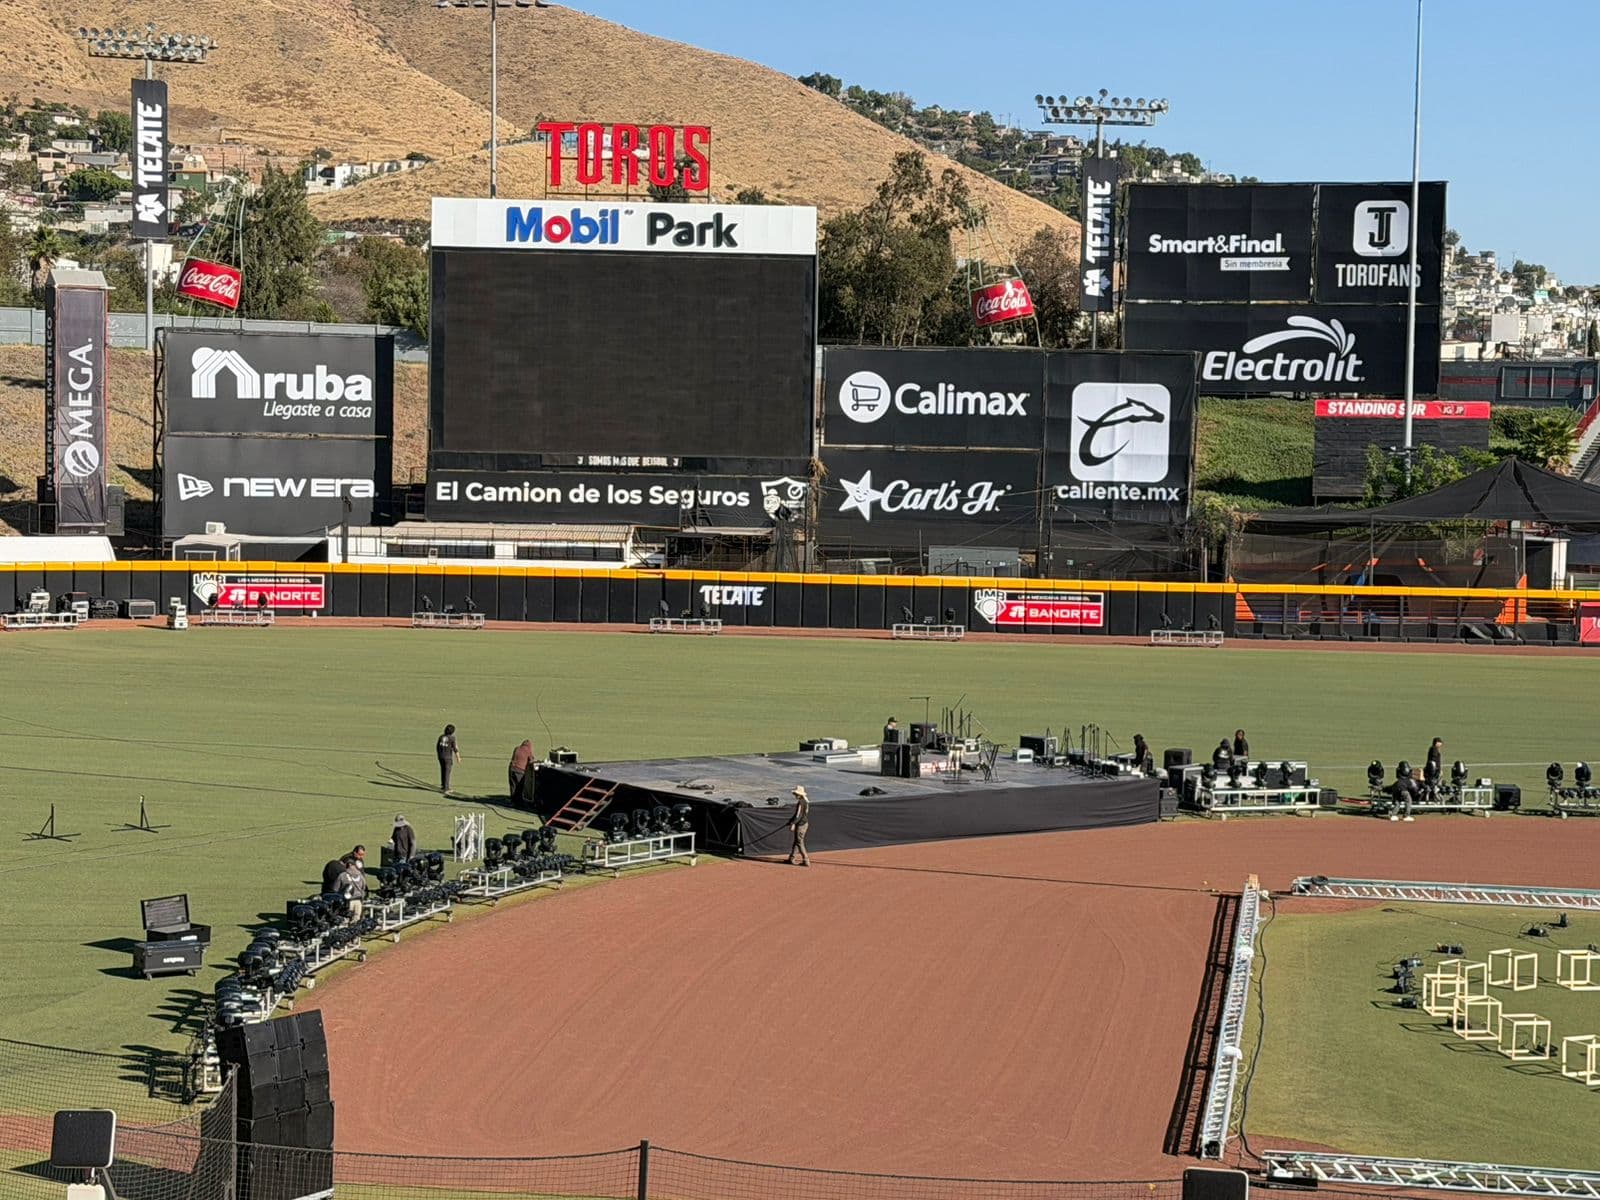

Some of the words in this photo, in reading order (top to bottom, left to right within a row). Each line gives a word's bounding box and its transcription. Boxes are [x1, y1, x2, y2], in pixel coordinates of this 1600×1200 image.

[137, 98, 163, 189] TECATE
[537, 121, 711, 192] TOROS
[506, 207, 619, 244] Mobil
[647, 212, 738, 248] Park
[1086, 176, 1112, 264] TECATE
[1224, 260, 1237, 268] Sin
[182, 267, 239, 301] Coca-Cola
[1202, 351, 1365, 382] Electrolit
[263, 401, 321, 420] Llegaste
[325, 406, 334, 417] a
[339, 404, 372, 418] casa
[895, 383, 1028, 415] Calimax
[1328, 402, 1396, 415] STANDING
[436, 481, 459, 501] El
[465, 482, 562, 503] Camion
[569, 484, 601, 503] de
[607, 484, 643, 504] los
[649, 485, 750, 509] Seguros
[880, 480, 961, 513] Carl's
[1057, 482, 1180, 501] caliente.mx
[699, 585, 767, 606] TECATE
[1029, 607, 1099, 620] BANORTE
